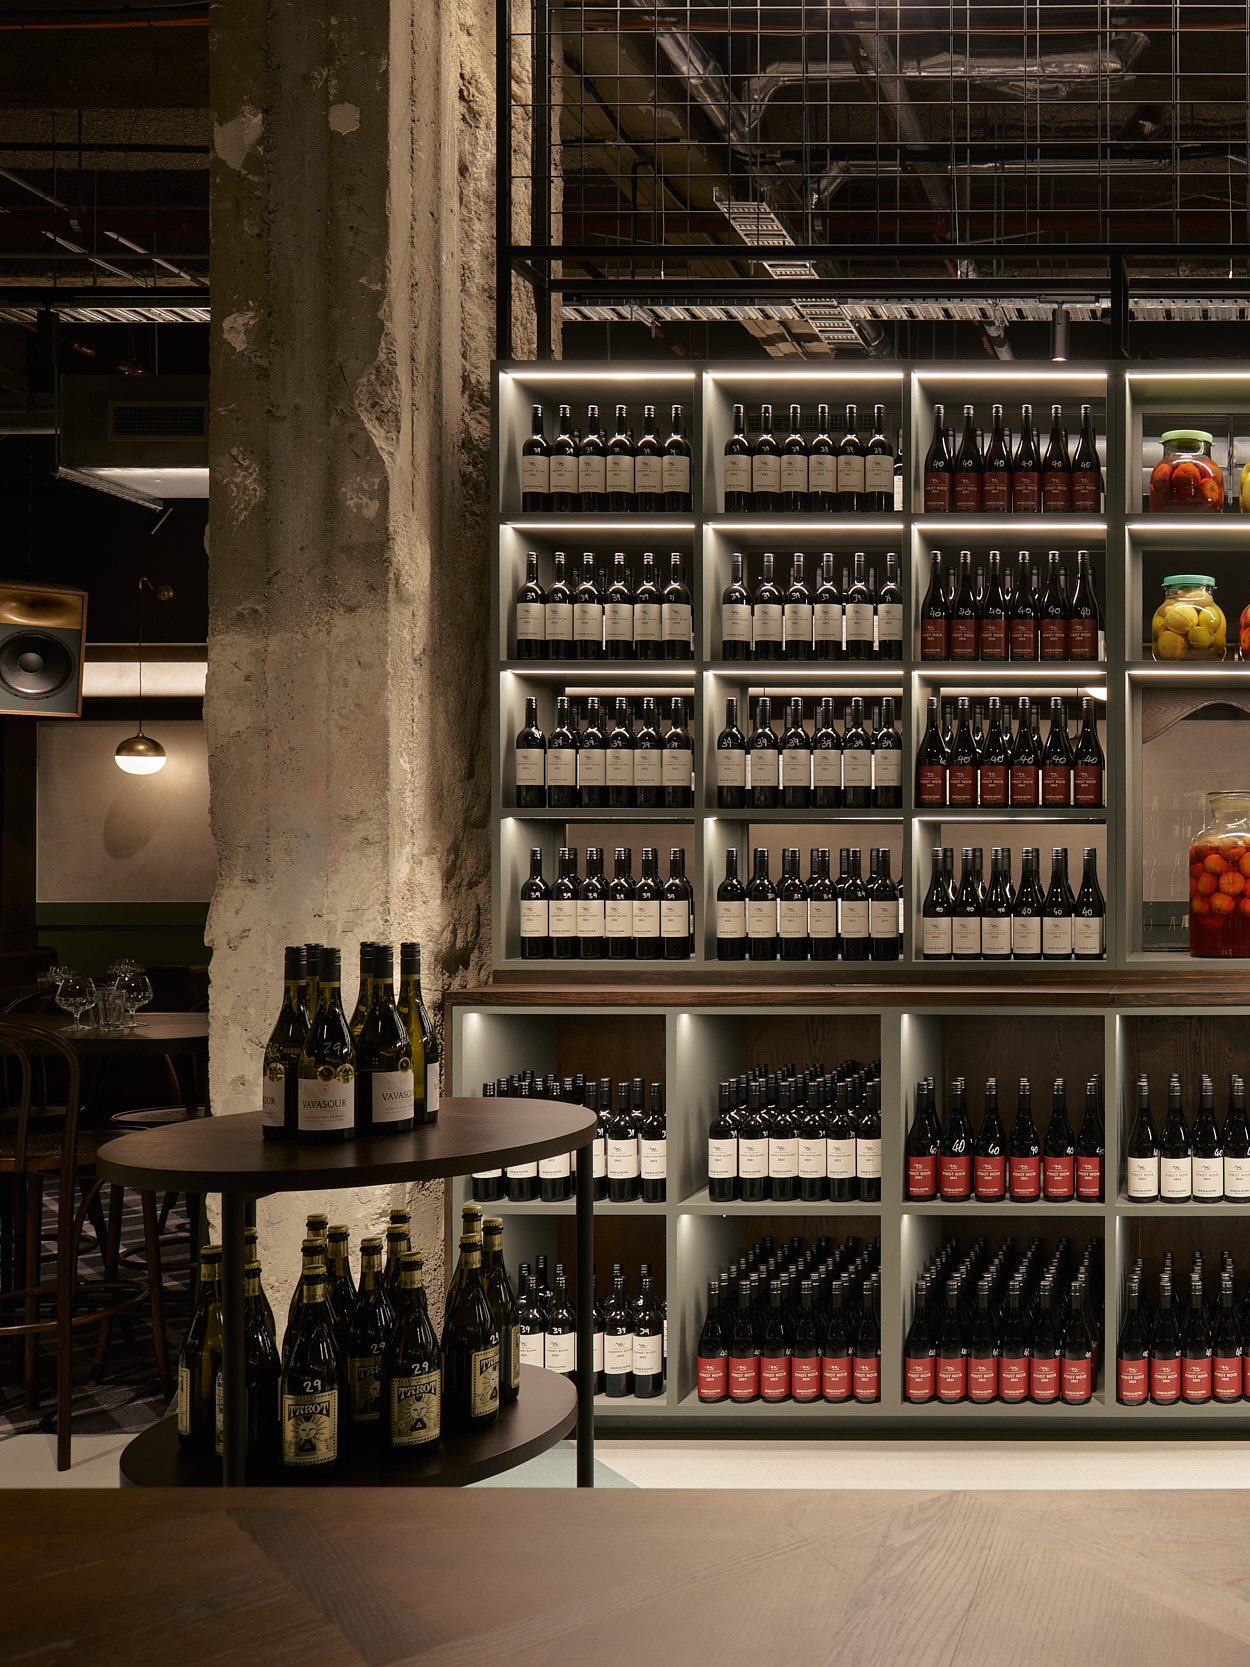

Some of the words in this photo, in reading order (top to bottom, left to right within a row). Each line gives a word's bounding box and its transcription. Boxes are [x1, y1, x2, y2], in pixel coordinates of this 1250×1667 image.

[962, 459, 973, 467] 40
[929, 609, 942, 617] 40
[1048, 607, 1061, 615] 40
[1080, 607, 1091, 616] 40
[958, 756, 971, 764] 40
[991, 755, 1004, 763] 40
[1020, 755, 1034, 764] 40
[1052, 755, 1067, 764] 40
[1085, 756, 1097, 764] 40
[1021, 907, 1032, 915] 40
[1082, 908, 1093, 916] 40
[323, 1042, 341, 1055] 29
[382, 1089, 414, 1101] VAVASOU
[302, 1099, 347, 1109] VAVASOUR
[520, 1325, 530, 1333] 39
[371, 1342, 386, 1354] 29
[359, 1366, 381, 1379] TAR
[411, 1362, 429, 1374] 29
[303, 1379, 322, 1393] 29
[399, 1381, 437, 1399] TAROT
[289, 1401, 329, 1419] TAROT
